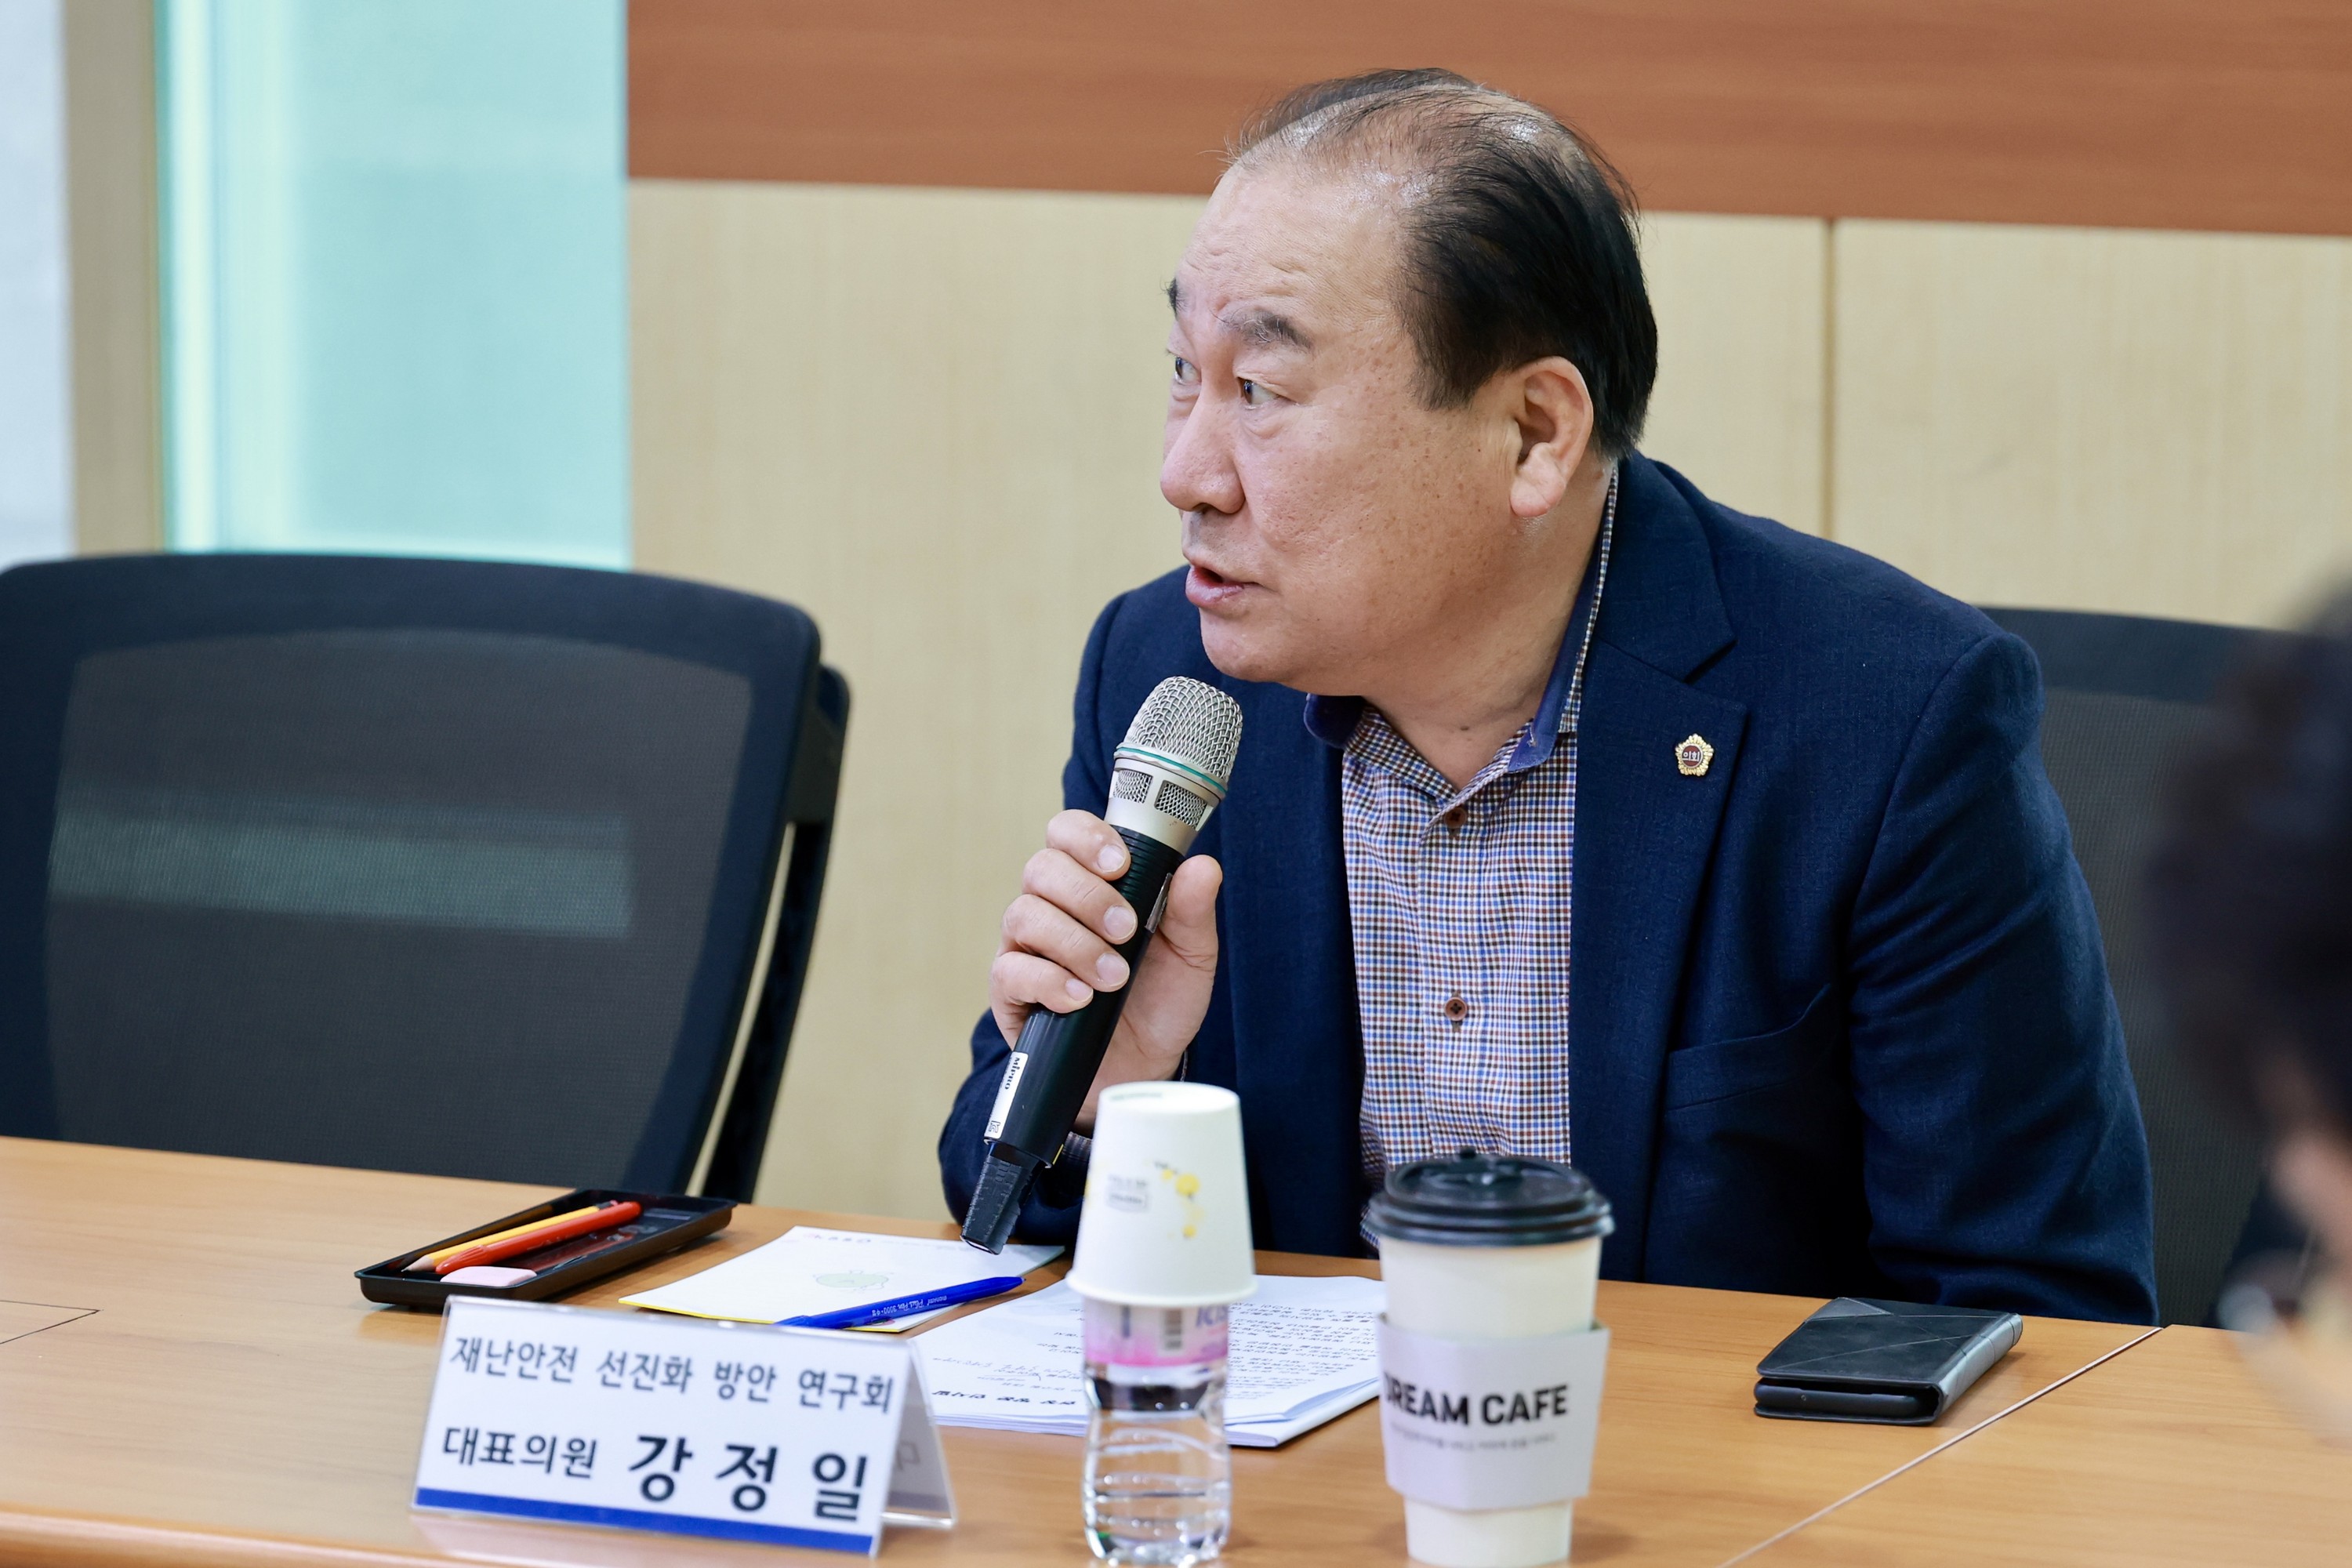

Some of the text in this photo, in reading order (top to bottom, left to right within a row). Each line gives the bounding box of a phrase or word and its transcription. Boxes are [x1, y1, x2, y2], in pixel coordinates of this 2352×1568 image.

[1682, 750, 1700, 761] 의회
[450, 1337, 893, 1414] 재난안전 선진화 방안 연구회
[1482, 1385, 1567, 1425] CAFE
[444, 1427, 597, 1479] 대표의원
